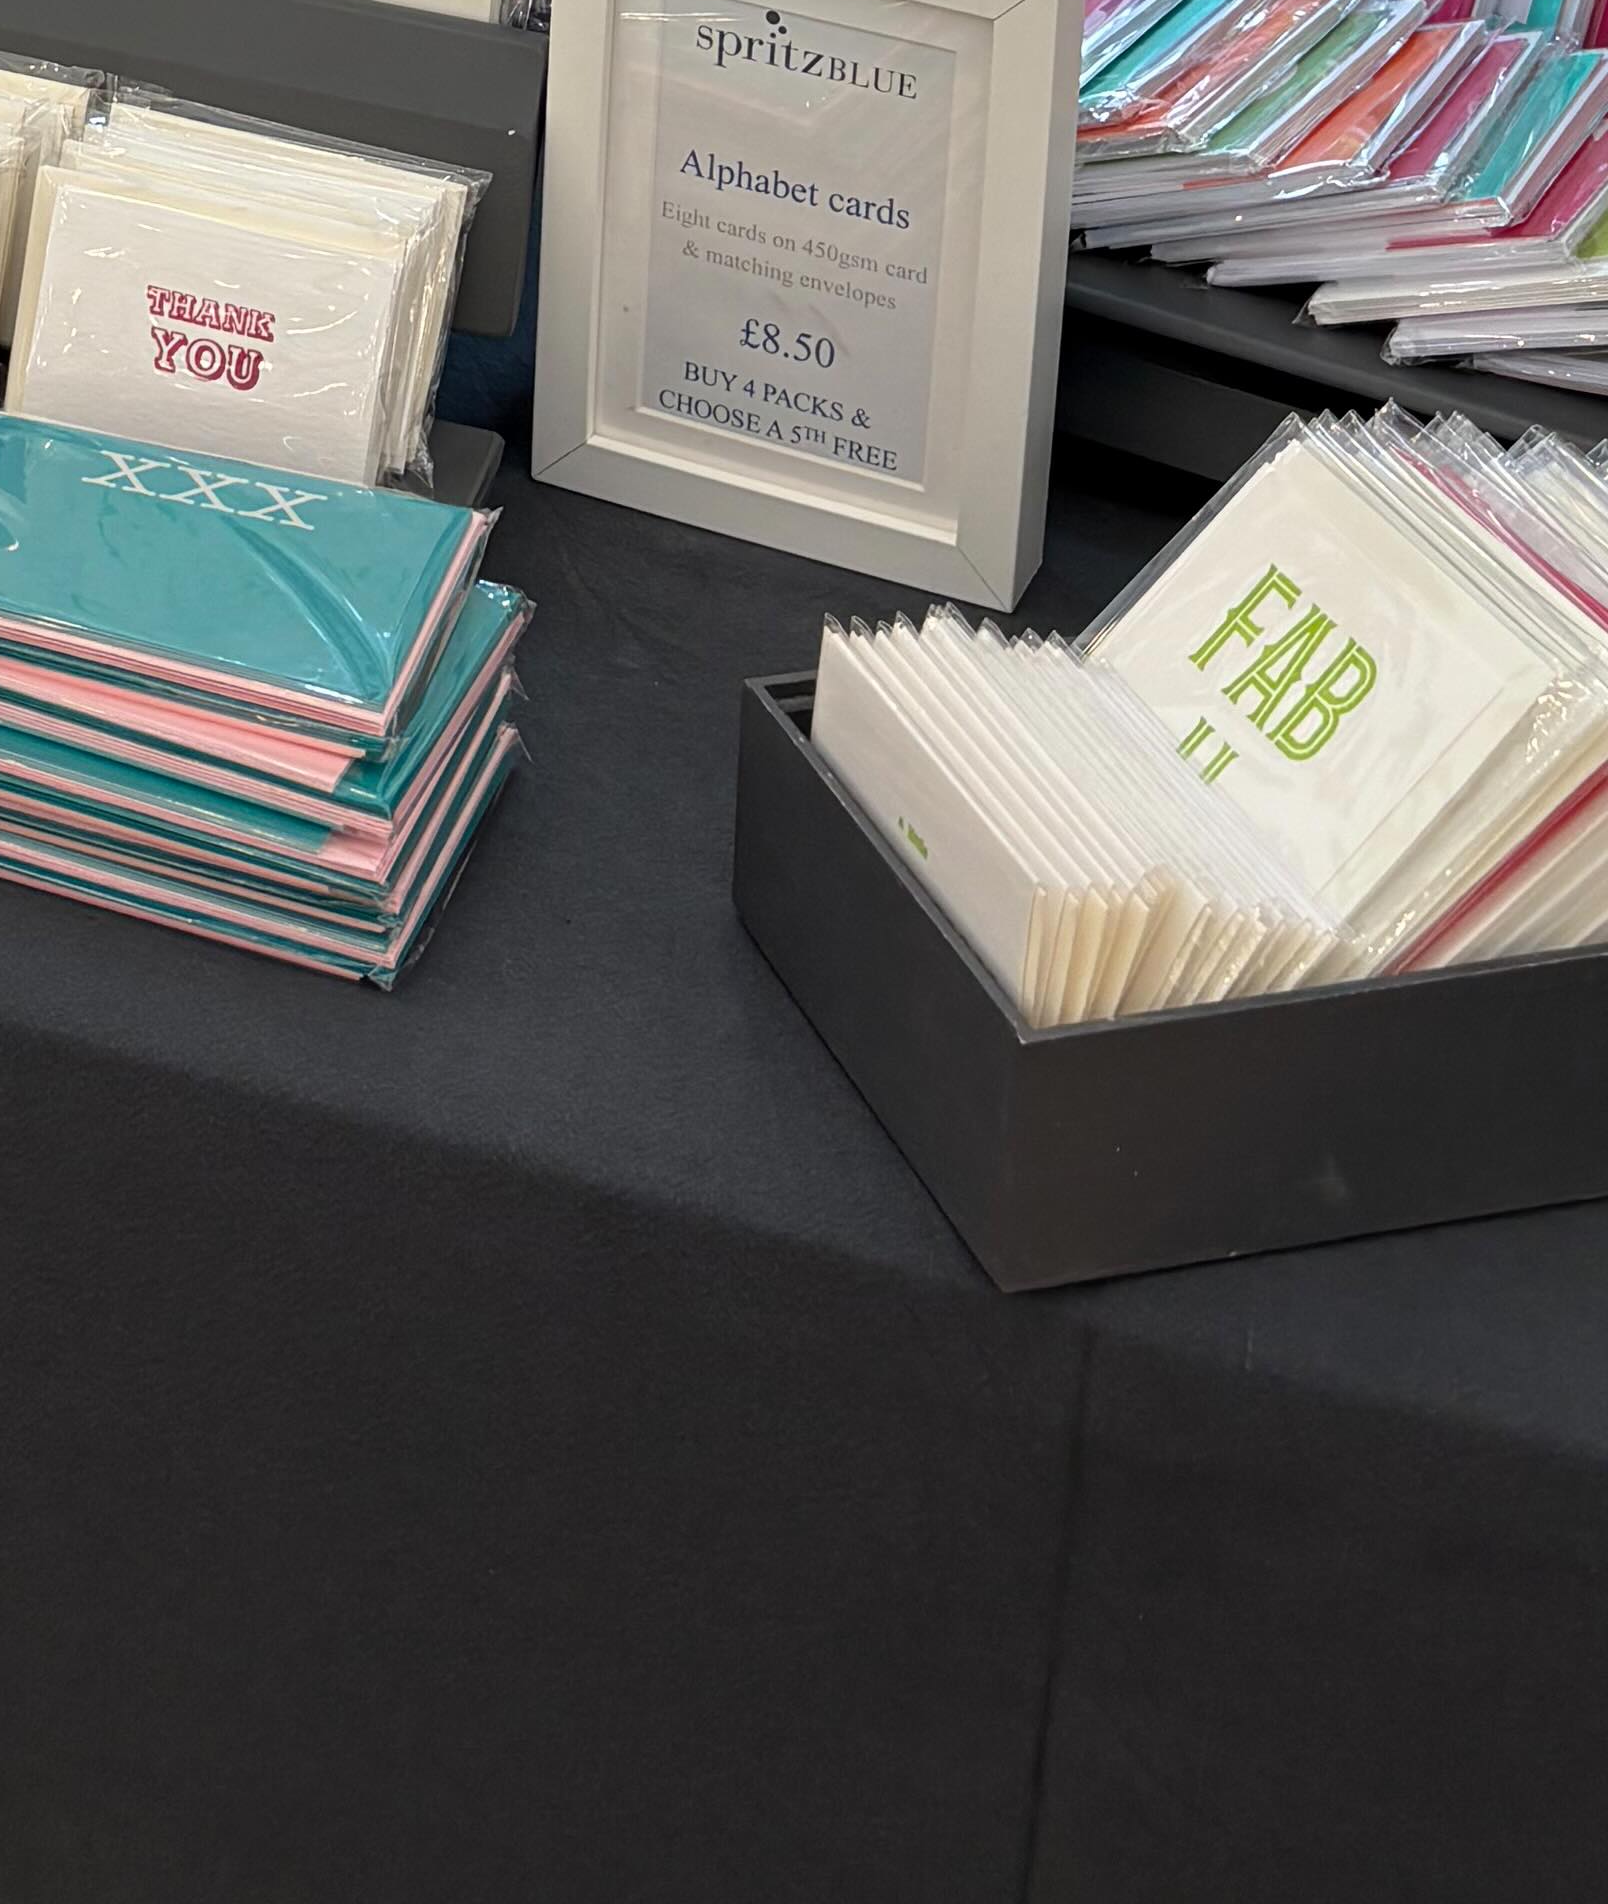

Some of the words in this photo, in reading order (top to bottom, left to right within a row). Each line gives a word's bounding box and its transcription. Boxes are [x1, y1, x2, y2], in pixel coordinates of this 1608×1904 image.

[696, 11, 917, 100] spritzBLUE
[680, 149, 819, 207] Alphabet
[828, 192, 910, 229] cards
[662, 201, 711, 230] Eight
[716, 217, 766, 244] cards
[773, 234, 796, 252] on
[801, 238, 878, 273] 450gsm
[885, 263, 928, 285] card
[682, 239, 699, 259] &
[706, 247, 794, 288] matching
[799, 274, 896, 310] envelopes
[147, 285, 276, 342] THANK
[739, 318, 835, 368] £8.50
[151, 325, 264, 391] YOU
[684, 361, 738, 392] BUY
[743, 379, 756, 398] 4
[763, 383, 844, 422] PACKS
[851, 408, 871, 429] &
[659, 389, 761, 434] CHOOSE
[766, 420, 783, 440] A
[832, 436, 898, 471] FREE
[82, 449, 328, 531] XXX
[1187, 562, 1377, 761] FAB
